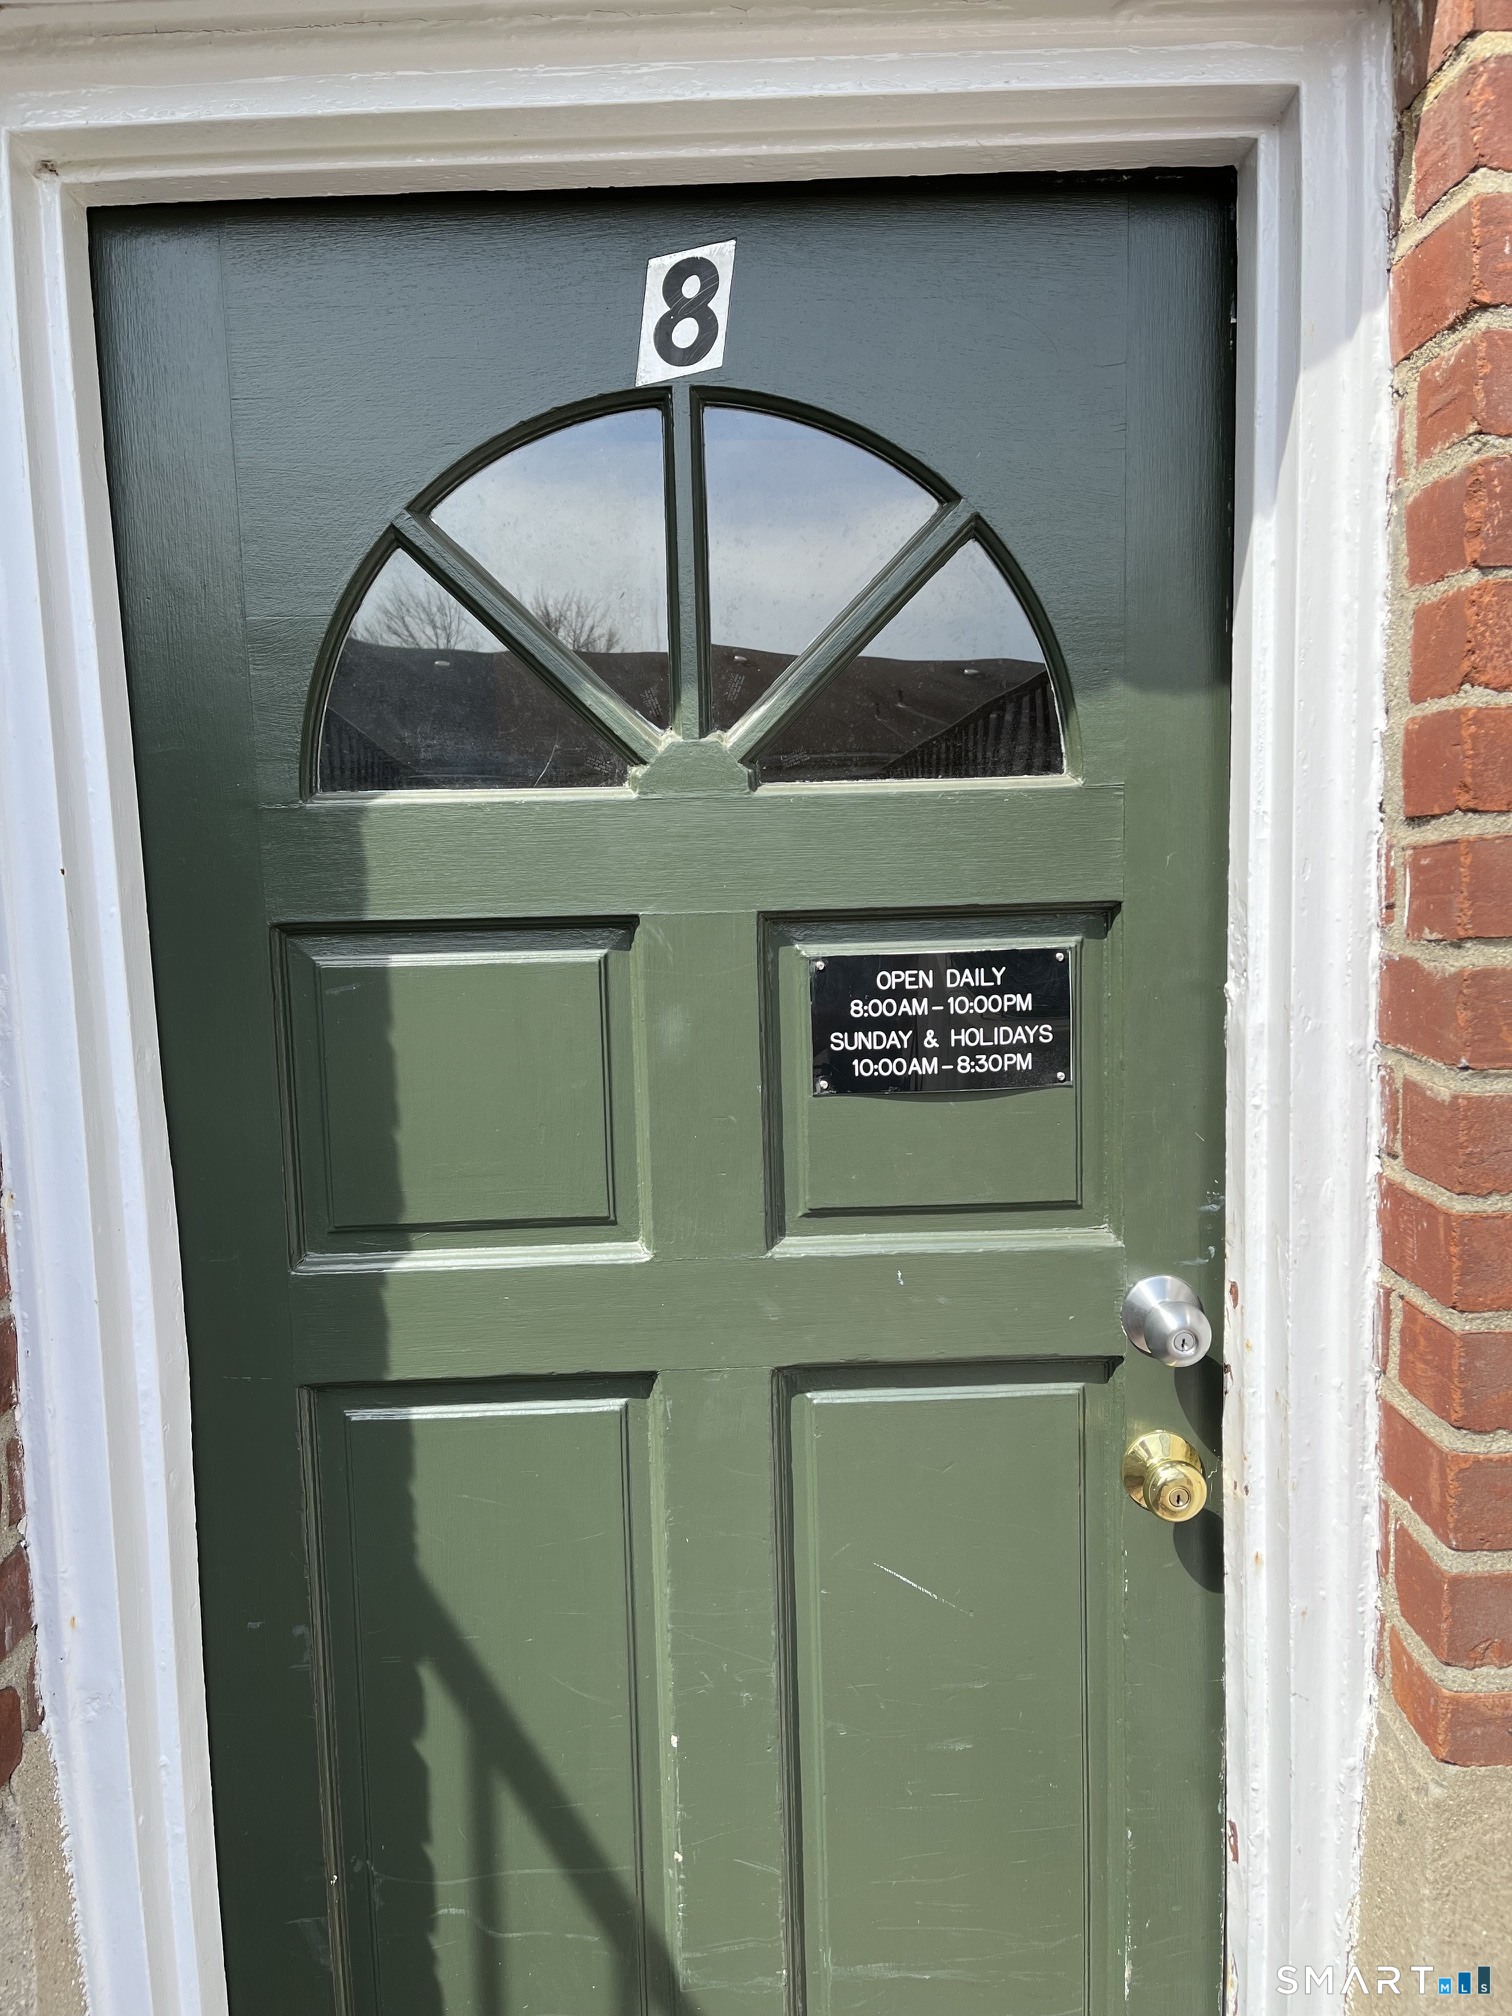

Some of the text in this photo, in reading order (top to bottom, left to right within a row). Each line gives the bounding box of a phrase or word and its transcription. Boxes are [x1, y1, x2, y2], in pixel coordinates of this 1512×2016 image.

[653, 256, 720, 367] 8
[876, 966, 1006, 990] OPEN DAILY
[830, 1024, 1053, 1051] SUNDAY & HOLIDAYS
